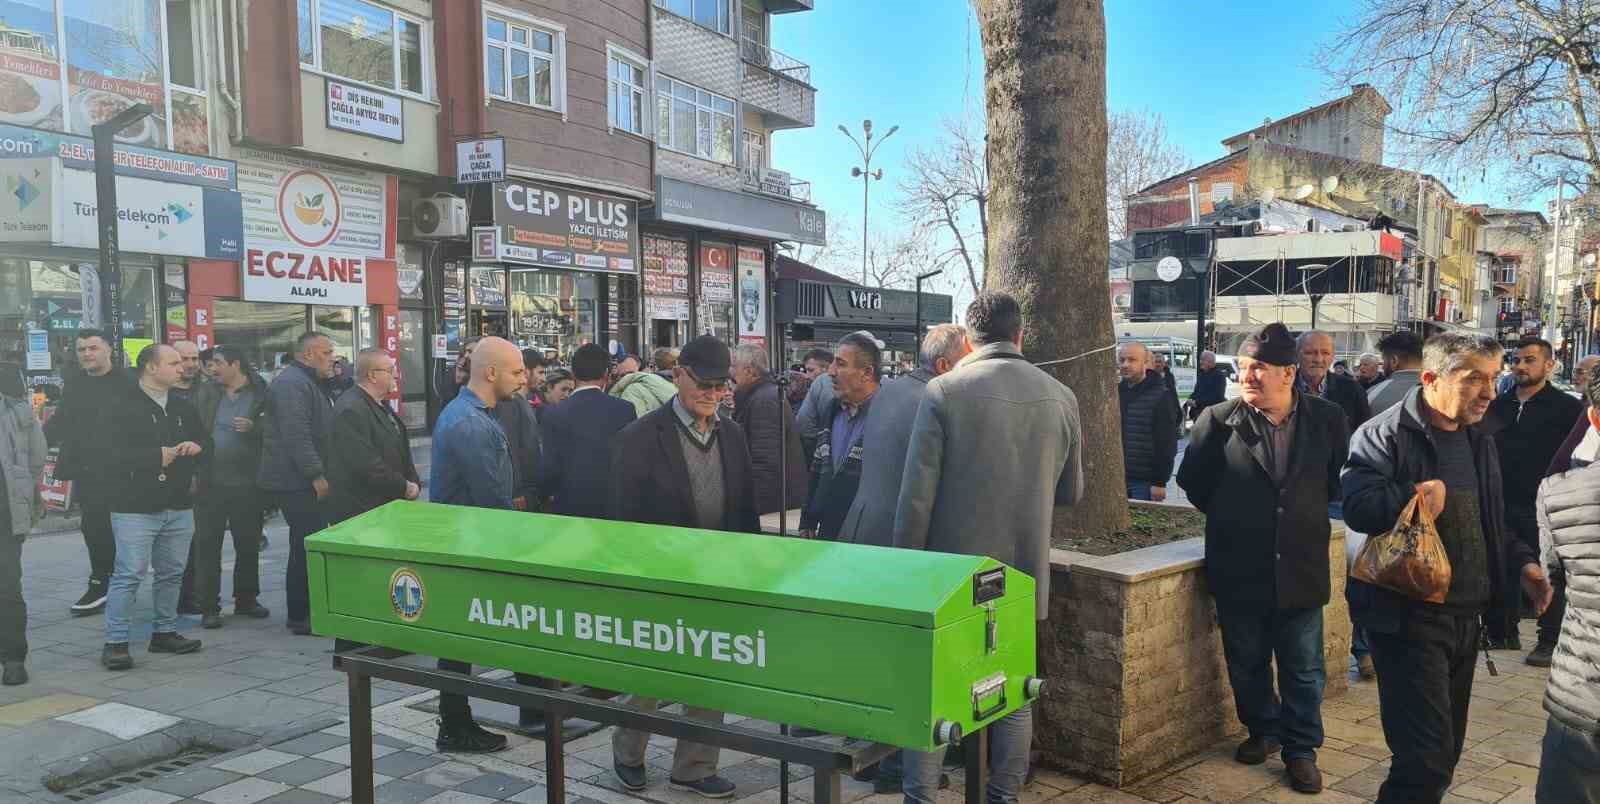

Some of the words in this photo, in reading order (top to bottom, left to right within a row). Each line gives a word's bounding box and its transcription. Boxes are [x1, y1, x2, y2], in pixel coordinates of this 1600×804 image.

[129, 152, 174, 172] TELEFON
[72, 201, 97, 217] Tür
[114, 205, 170, 226] elekom
[505, 184, 560, 216] CEP
[567, 195, 629, 228] PLUS
[800, 208, 822, 233] Kale
[247, 248, 363, 284] ECZANE
[290, 286, 328, 298] ALAPLI
[849, 289, 882, 310] vera
[467, 596, 564, 637] ALAPLI
[574, 611, 767, 668] BELEDİYESİ
